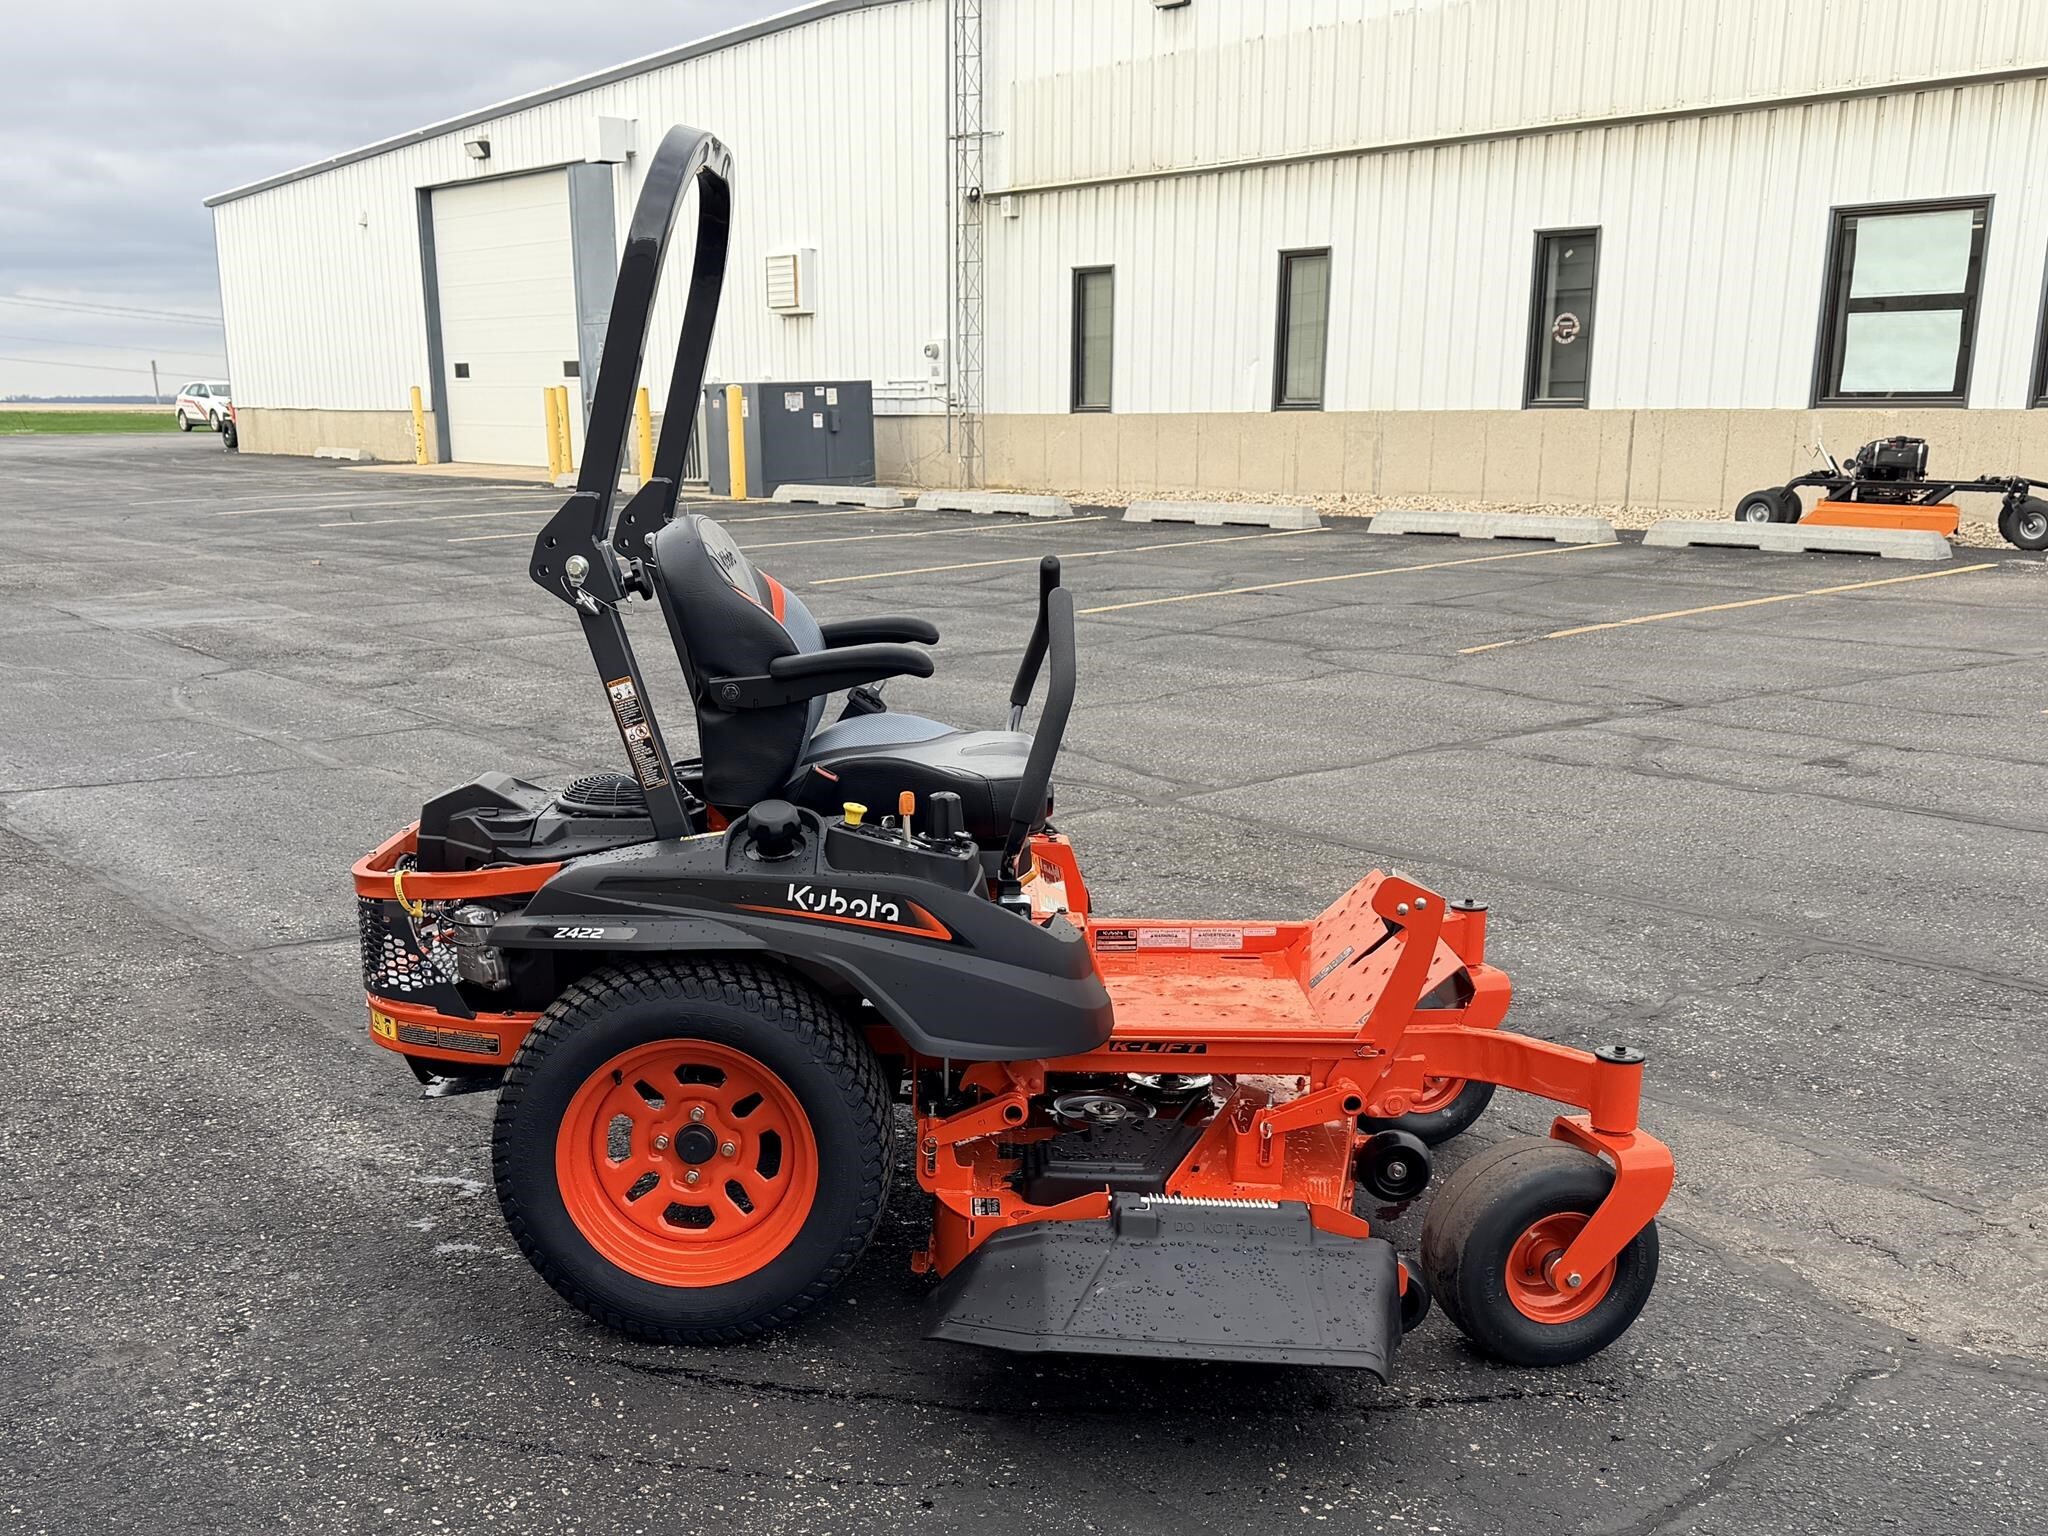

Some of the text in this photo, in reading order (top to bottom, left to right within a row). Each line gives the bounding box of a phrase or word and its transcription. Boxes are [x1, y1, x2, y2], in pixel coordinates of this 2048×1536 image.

[787, 883, 899, 922] Kubota
[553, 927, 605, 939] Z422
[1111, 1041, 1205, 1053] K-LIFT
[1175, 1222, 1298, 1236] DO NOT REMOVE
